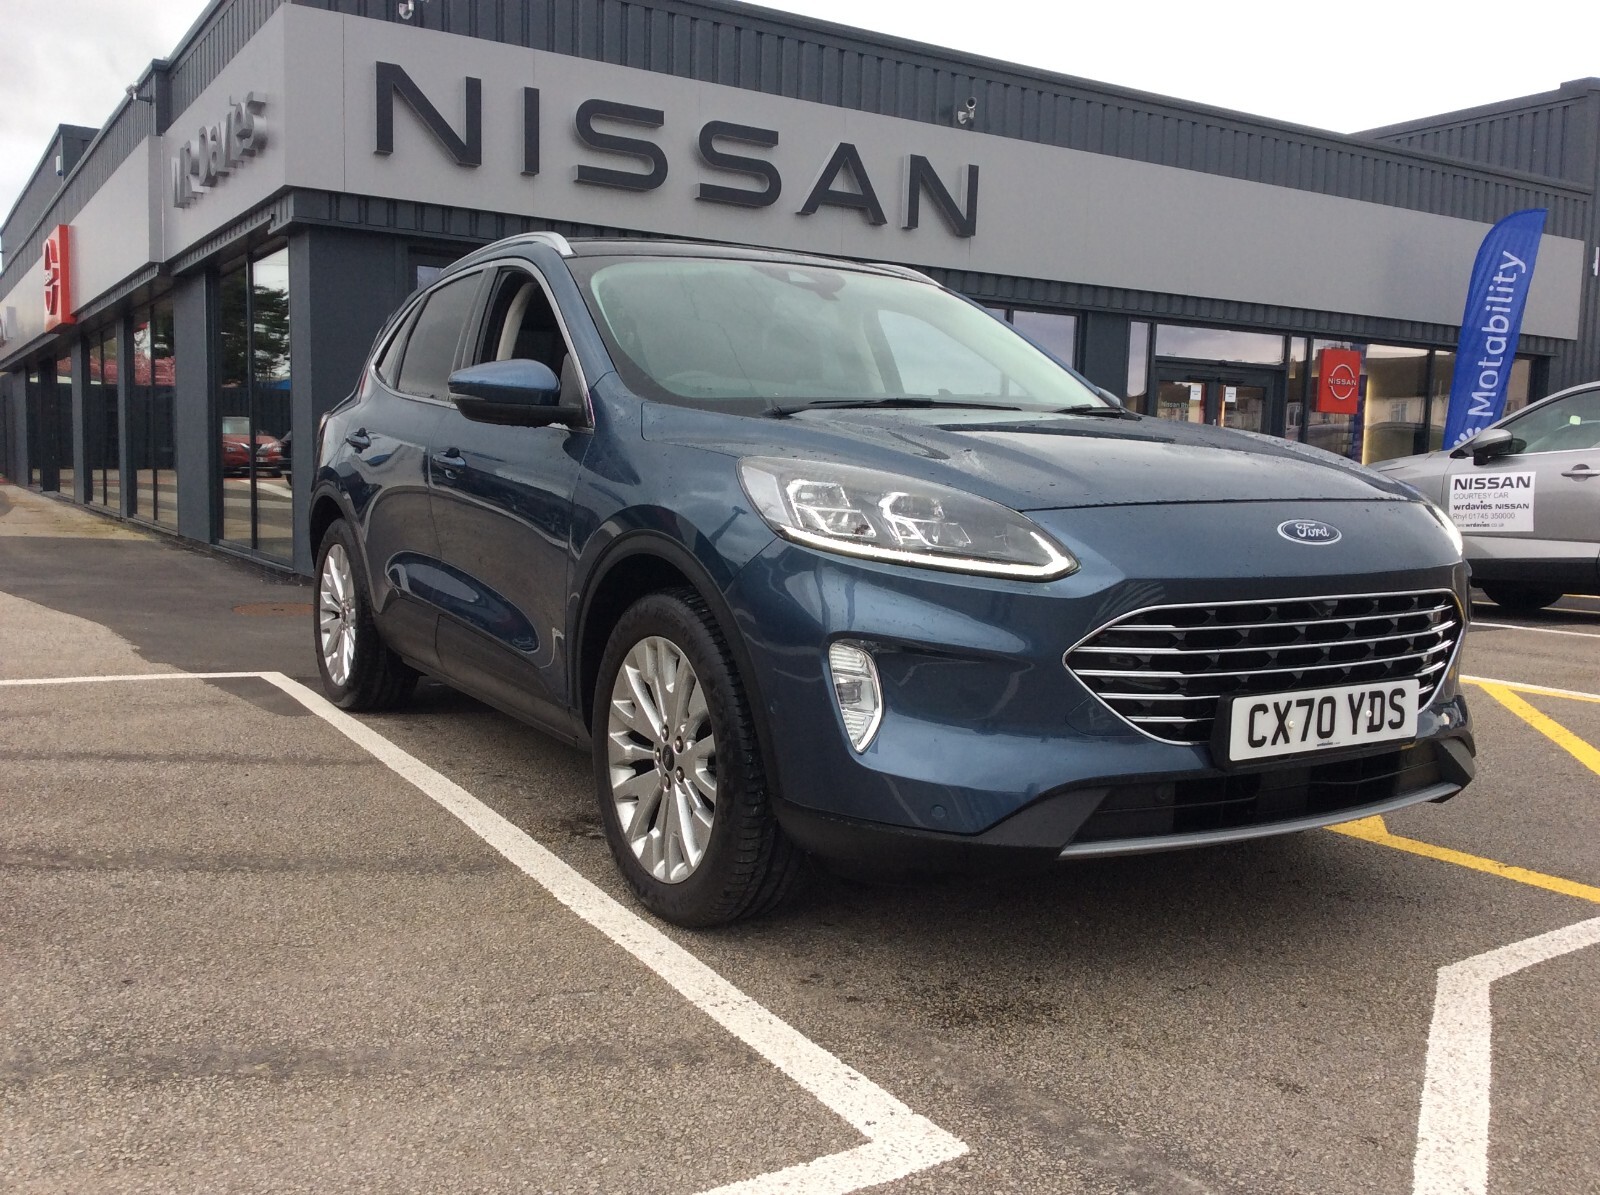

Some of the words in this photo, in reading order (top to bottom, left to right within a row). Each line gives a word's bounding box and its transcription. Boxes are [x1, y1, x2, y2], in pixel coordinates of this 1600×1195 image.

[374, 61, 979, 237] NISSAN
[1468, 250, 1527, 417] Motability
[1328, 377, 1357, 386] NISSAN
[1454, 476, 1532, 490] NISSAN
[1453, 492, 1492, 500] COURTESY
[1493, 491, 1509, 499] CAR
[1453, 500, 1493, 511] wrdavies
[1468, 512, 1489, 520] 01745
[1490, 511, 1516, 520] 350000
[1295, 522, 1330, 538] Ford
[1247, 695, 1337, 749] CX70
[1347, 687, 1406, 736] YDS
